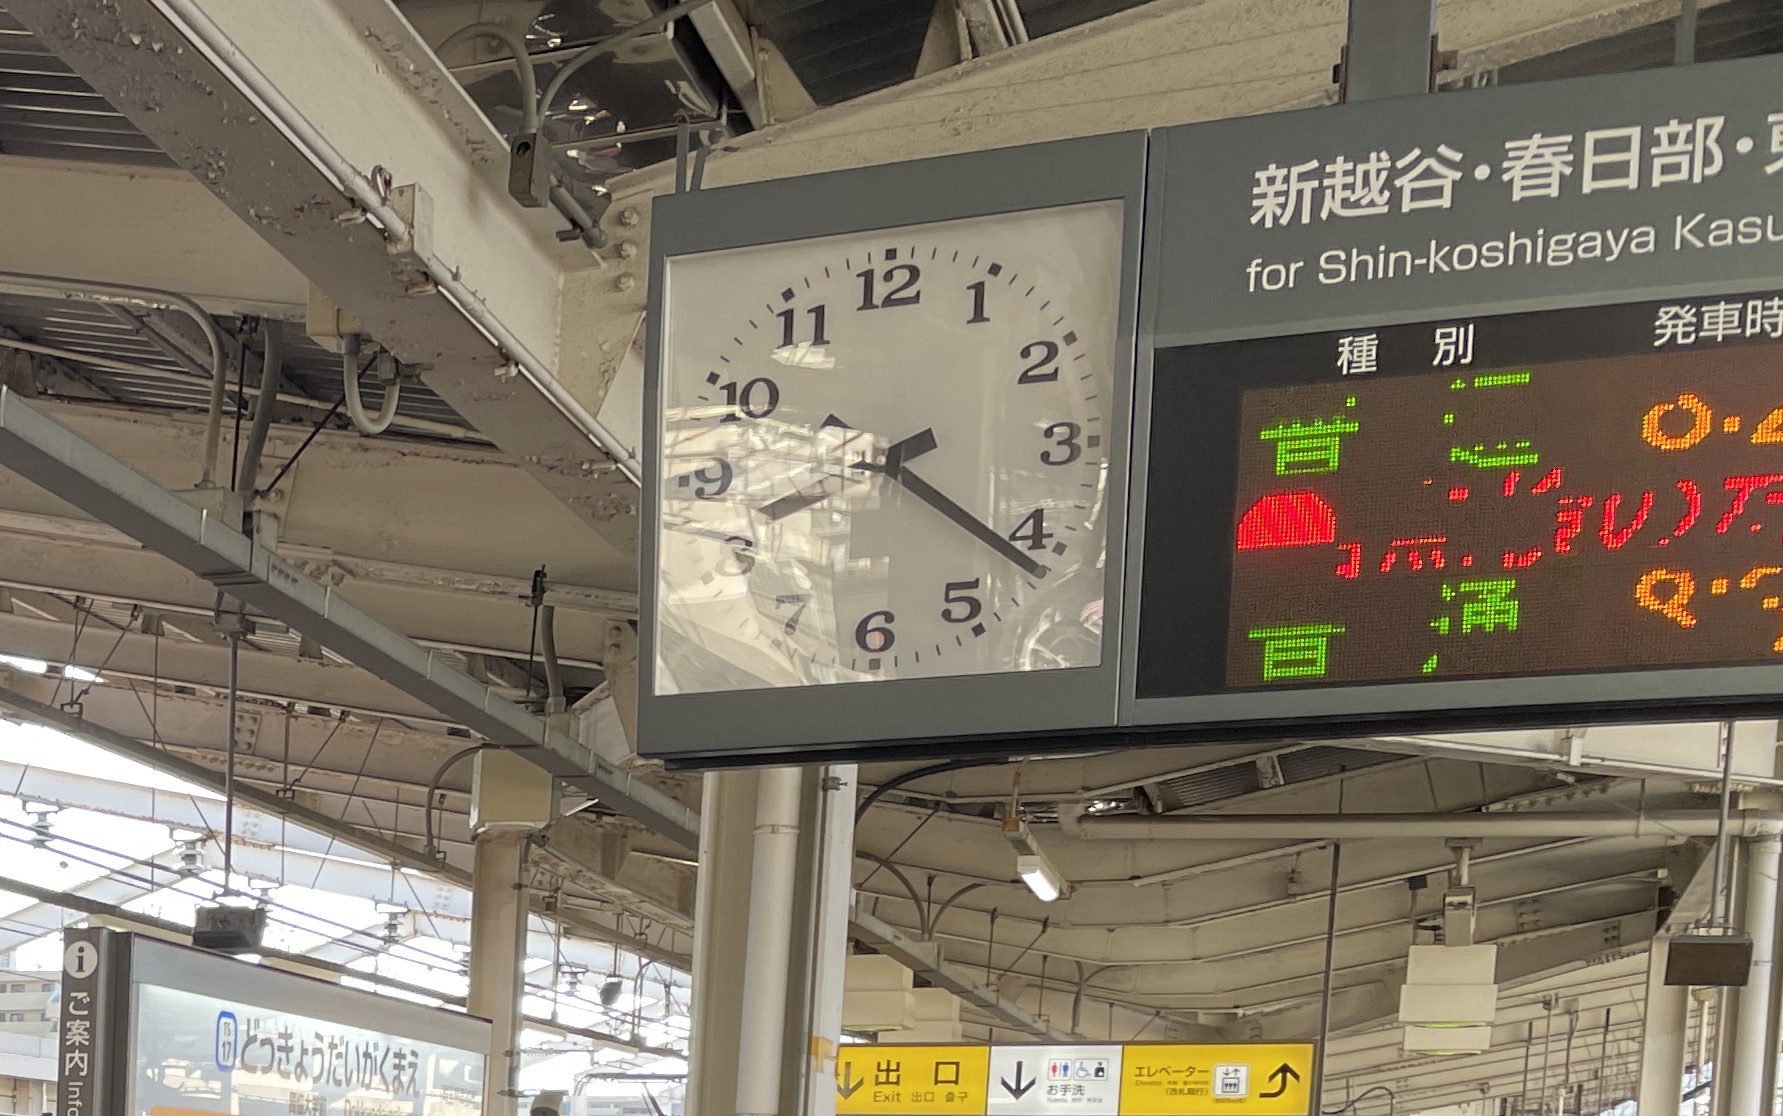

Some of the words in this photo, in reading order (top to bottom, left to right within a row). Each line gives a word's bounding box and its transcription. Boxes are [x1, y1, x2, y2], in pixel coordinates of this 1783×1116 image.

[1249, 112, 1783, 228] 新越谷・春日部・
[1246, 258, 1304, 292] for
[1318, 224, 1655, 285] Shin-koshigaya
[1674, 211, 1783, 251] Kasu
[855, 264, 922, 312] 12
[965, 281, 991, 325] 1
[775, 304, 831, 350] 11
[1653, 297, 1783, 348] 発車時
[1016, 340, 1060, 385] 2
[718, 377, 780, 424] 10
[1039, 421, 1082, 466] 3
[693, 456, 734, 500] 9
[1008, 507, 1054, 551] 4
[775, 594, 809, 636] 7
[941, 577, 983, 624] 5
[855, 609, 896, 653] 6
[64, 990, 91, 1077] ご案内
[221, 1041, 232, 1063] 17
[239, 1017, 420, 1098] どっきょうだいがくまえ
[874, 1060, 961, 1086] 出口
[1134, 1065, 1211, 1078] エレベーター
[872, 1090, 902, 1103] Exit
[1046, 1084, 1086, 1097] お手洗
